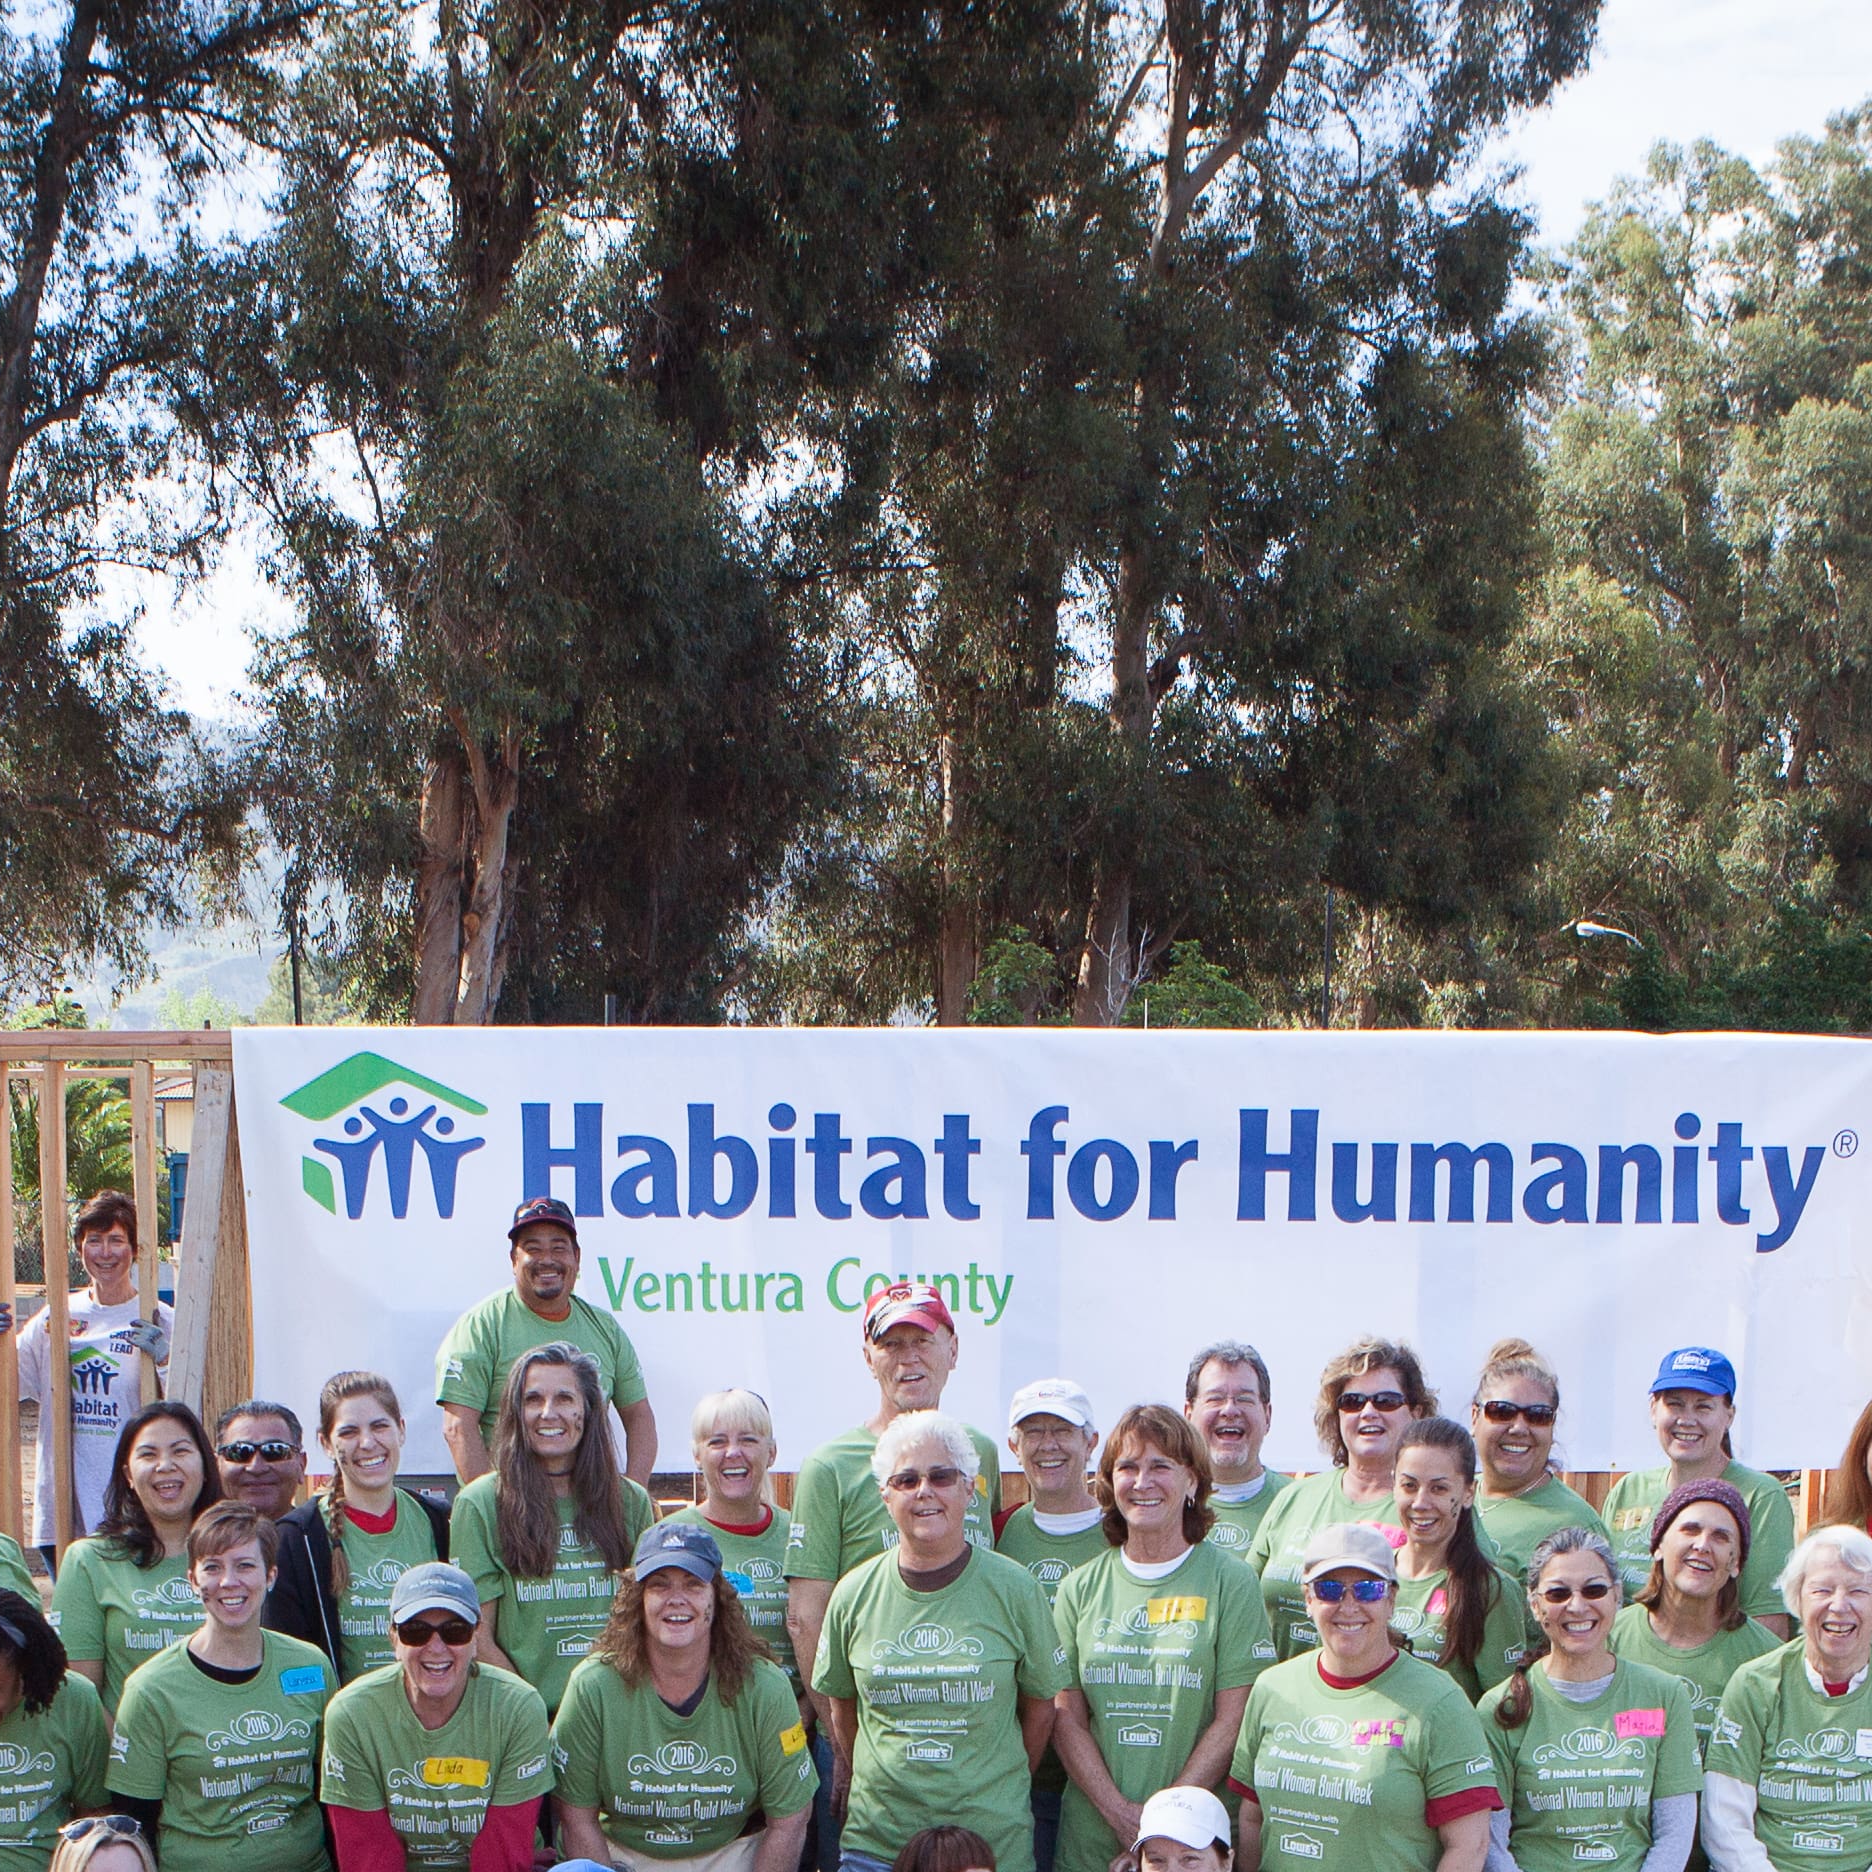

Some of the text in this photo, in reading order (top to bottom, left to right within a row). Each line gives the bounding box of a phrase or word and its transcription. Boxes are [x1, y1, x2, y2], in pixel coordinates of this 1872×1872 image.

[520, 1101, 982, 1222] Habitat
[1019, 1105, 1198, 1222] for
[598, 1257, 803, 1312] Ventura
[72, 1400, 118, 1417] abitat
[749, 1561, 773, 1579] 2016
[516, 1579, 586, 1602] National Women
[750, 1608, 783, 1626] Women
[124, 1628, 163, 1649] National
[914, 1629, 940, 1648] 2016
[887, 1664, 919, 1675] Habitat
[921, 1664, 936, 1675] for
[1117, 1663, 1203, 1691] Women Build Week
[903, 1682, 967, 1704] Women Build
[245, 1718, 271, 1736] 2016
[1312, 1720, 1338, 1738] 2016
[1576, 1732, 1604, 1752] 2016
[670, 1745, 695, 1766] 2016
[1552, 1768, 1585, 1779] Habitat
[1587, 1768, 1600, 1778] for
[199, 1776, 240, 1799] National
[1281, 1768, 1372, 1807] Women Build Week
[1567, 1786, 1633, 1809] Women Build
[1759, 1775, 1793, 1801] National
[1795, 1779, 1833, 1802] Women
[613, 1796, 690, 1819] National Women
[1280, 1807, 1319, 1822] partnership
[451, 1813, 477, 1833] Build
